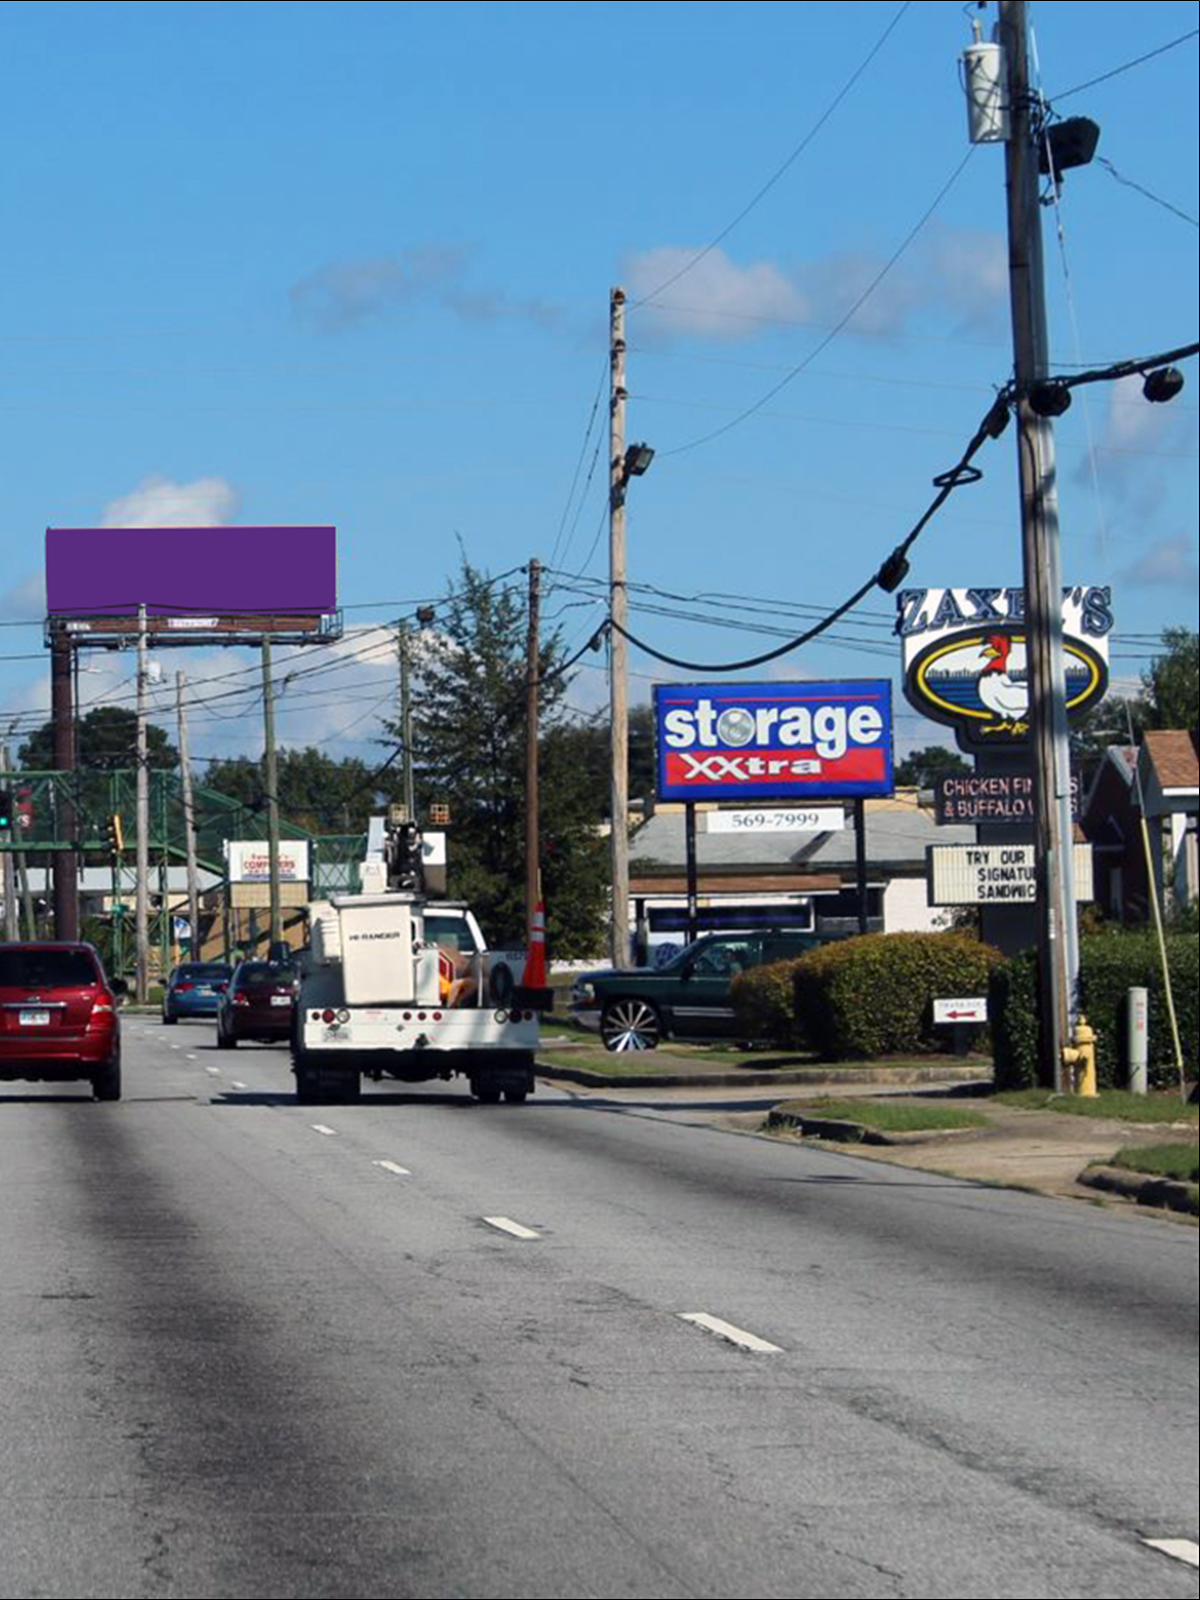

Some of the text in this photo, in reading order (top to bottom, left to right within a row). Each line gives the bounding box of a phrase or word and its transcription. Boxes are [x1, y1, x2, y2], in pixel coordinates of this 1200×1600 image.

[894, 586, 1114, 637] ZAXB'S
[664, 699, 883, 759] storage
[943, 778, 1009, 796] CHICKEN
[944, 802, 954, 817] &
[957, 800, 1025, 817] BUFFALO
[731, 813, 820, 828] 569-7999
[966, 850, 1026, 865] TRY OUR
[977, 867, 1036, 882] SIGNATU
[977, 884, 1037, 899] SANDWIC
